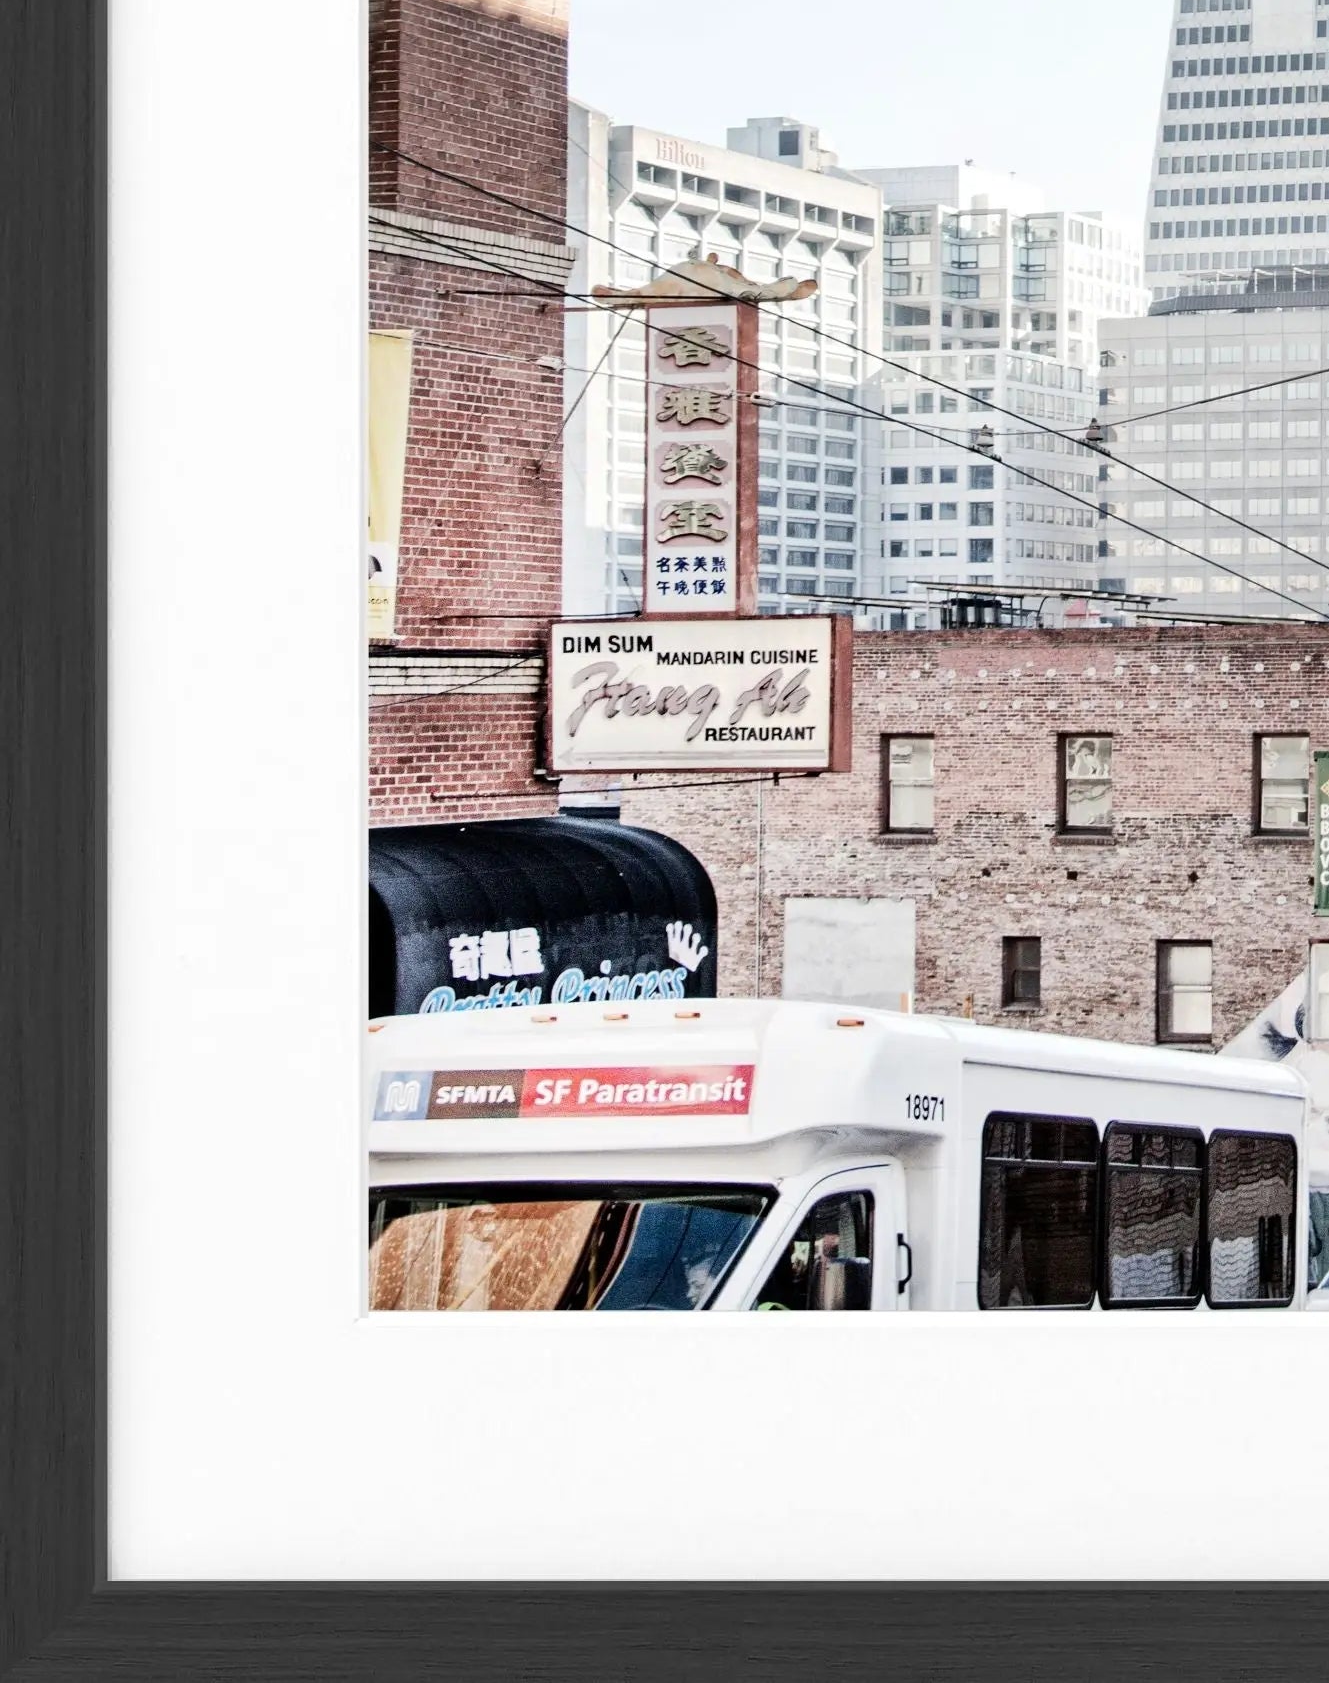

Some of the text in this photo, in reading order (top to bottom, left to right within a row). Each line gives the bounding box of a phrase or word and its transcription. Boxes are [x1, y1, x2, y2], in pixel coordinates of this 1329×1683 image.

[656, 138, 705, 169] Hilton
[562, 635, 653, 654] DIM SUM
[656, 649, 819, 666] MANDARIN CUISINE
[565, 660, 811, 743] Hang Ah
[705, 726, 816, 742] RESTAURANT
[436, 1084, 517, 1105] SFMTA
[534, 1079, 573, 1105] SF
[577, 1076, 746, 1105] Paratransit
[905, 1094, 945, 1121] 18971
